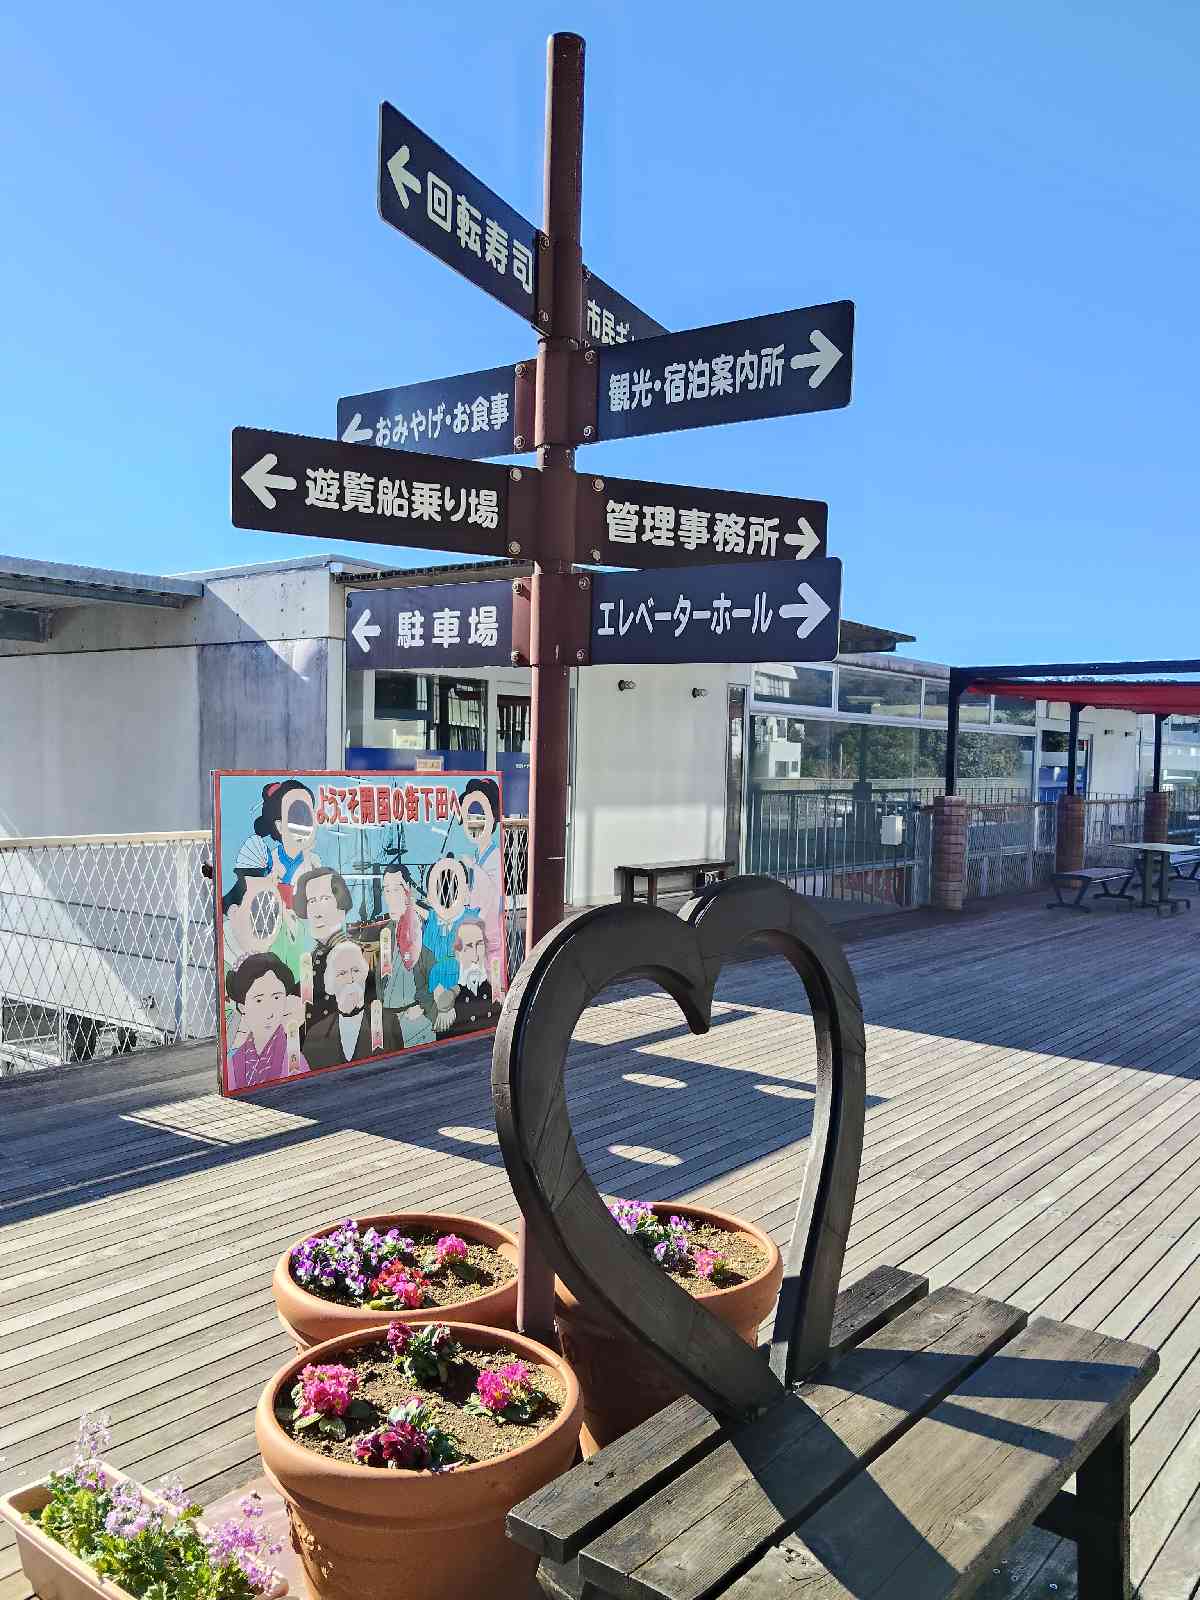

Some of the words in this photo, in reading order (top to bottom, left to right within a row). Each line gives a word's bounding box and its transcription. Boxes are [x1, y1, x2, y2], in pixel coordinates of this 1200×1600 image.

[427, 171, 533, 294] 回転寿司
[586, 299, 635, 346] 市民ギ
[608, 344, 785, 412] 観光・宿泊案内所
[375, 392, 509, 447] おみやげ・お食事
[305, 467, 499, 529] 遊覧船乗り場
[606, 500, 780, 557] 管理事務所
[397, 606, 498, 648] 駐車場
[597, 591, 773, 637] エレベーターホール
[316, 784, 464, 825] ようこそ開国の街下田へ
